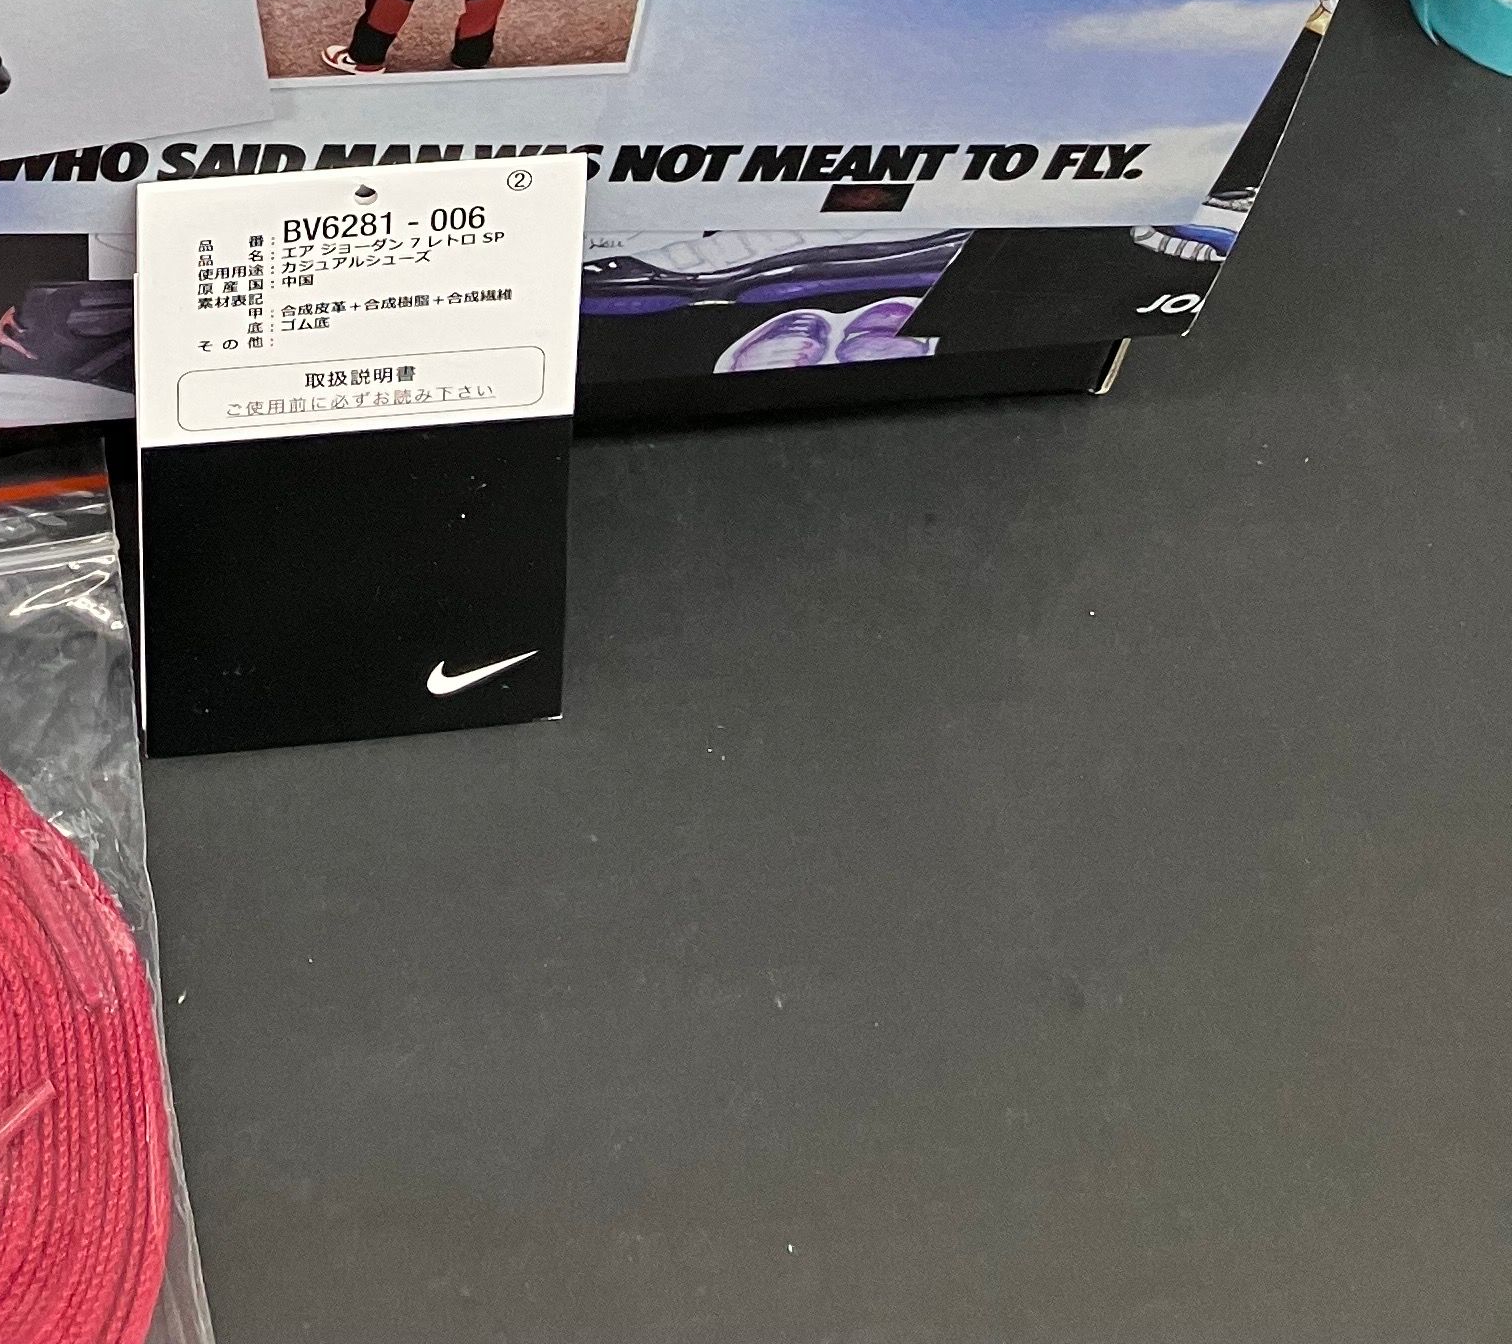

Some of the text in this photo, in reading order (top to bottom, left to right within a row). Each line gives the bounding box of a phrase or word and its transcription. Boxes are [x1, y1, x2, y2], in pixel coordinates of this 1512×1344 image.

[156, 142, 307, 183] SAID
[608, 143, 742, 182] NOT
[738, 143, 960, 182] MEANT
[962, 143, 1040, 182] TO
[1041, 143, 1152, 181] FLY.
[283, 211, 392, 243] BV6281
[430, 205, 486, 232] 006
[281, 273, 314, 288] 中国
[281, 317, 330, 332] ゴム底
[304, 365, 417, 389] 取扱説明書
[227, 384, 494, 417] ご使用前に必ずお読み下さい
